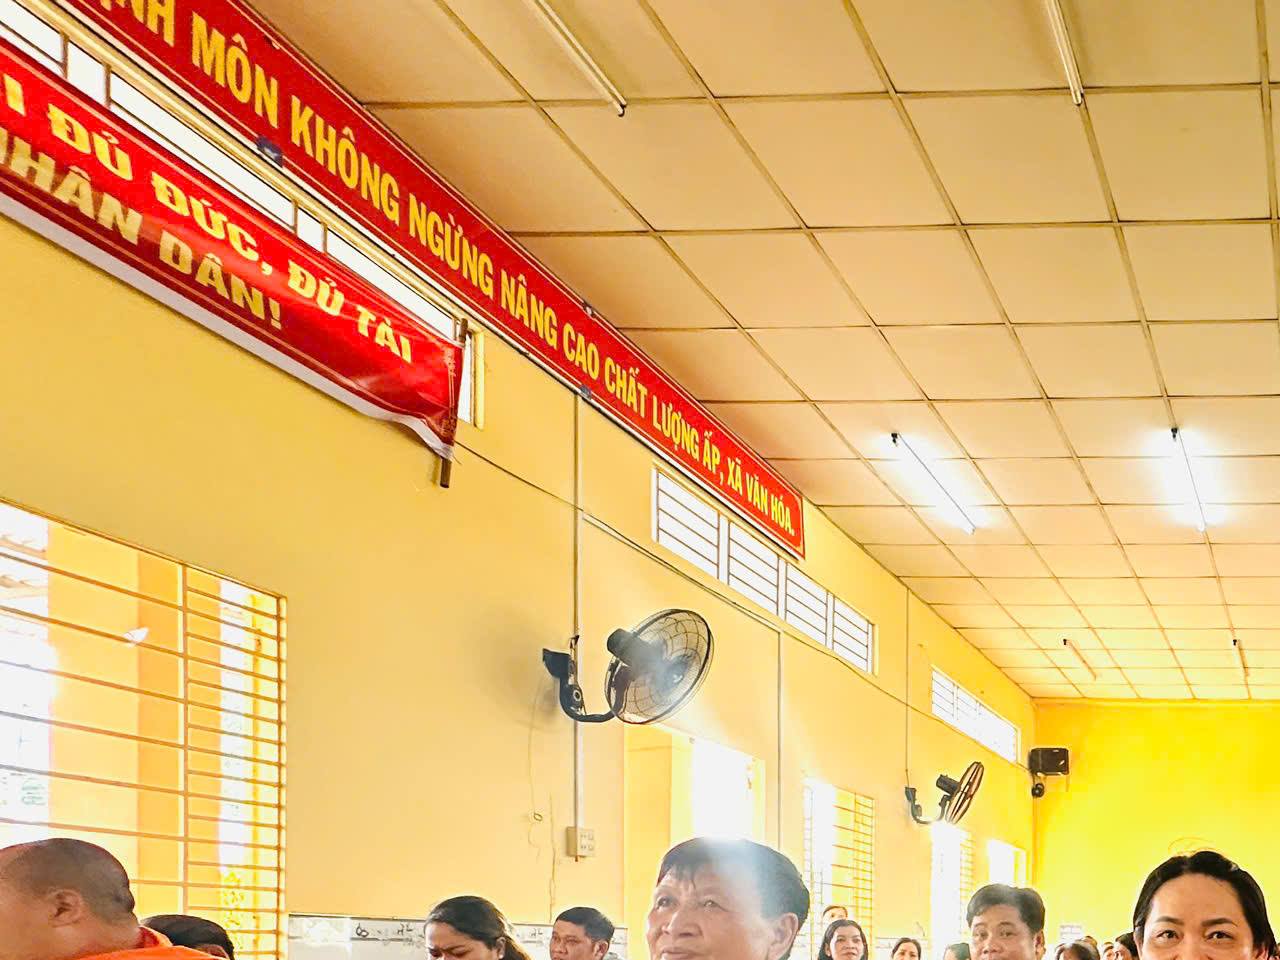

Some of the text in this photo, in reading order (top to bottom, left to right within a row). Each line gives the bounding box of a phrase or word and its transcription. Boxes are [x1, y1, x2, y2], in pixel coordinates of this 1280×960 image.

[47, 103, 133, 181] ĐỦ
[356, 304, 412, 364] TÀI
[159, 229, 281, 330] DÂN!
[192, 11, 278, 129] MÔN
[291, 94, 400, 226] KHÔNG
[408, 192, 494, 299] NGỪNG
[501, 269, 558, 350] NÂNG
[563, 323, 600, 380] CAO
[604, 357, 648, 418] CHẤT
[652, 394, 699, 461] LƯỢNG
[727, 457, 743, 496] XÃ
[746, 472, 768, 516] VĂN
